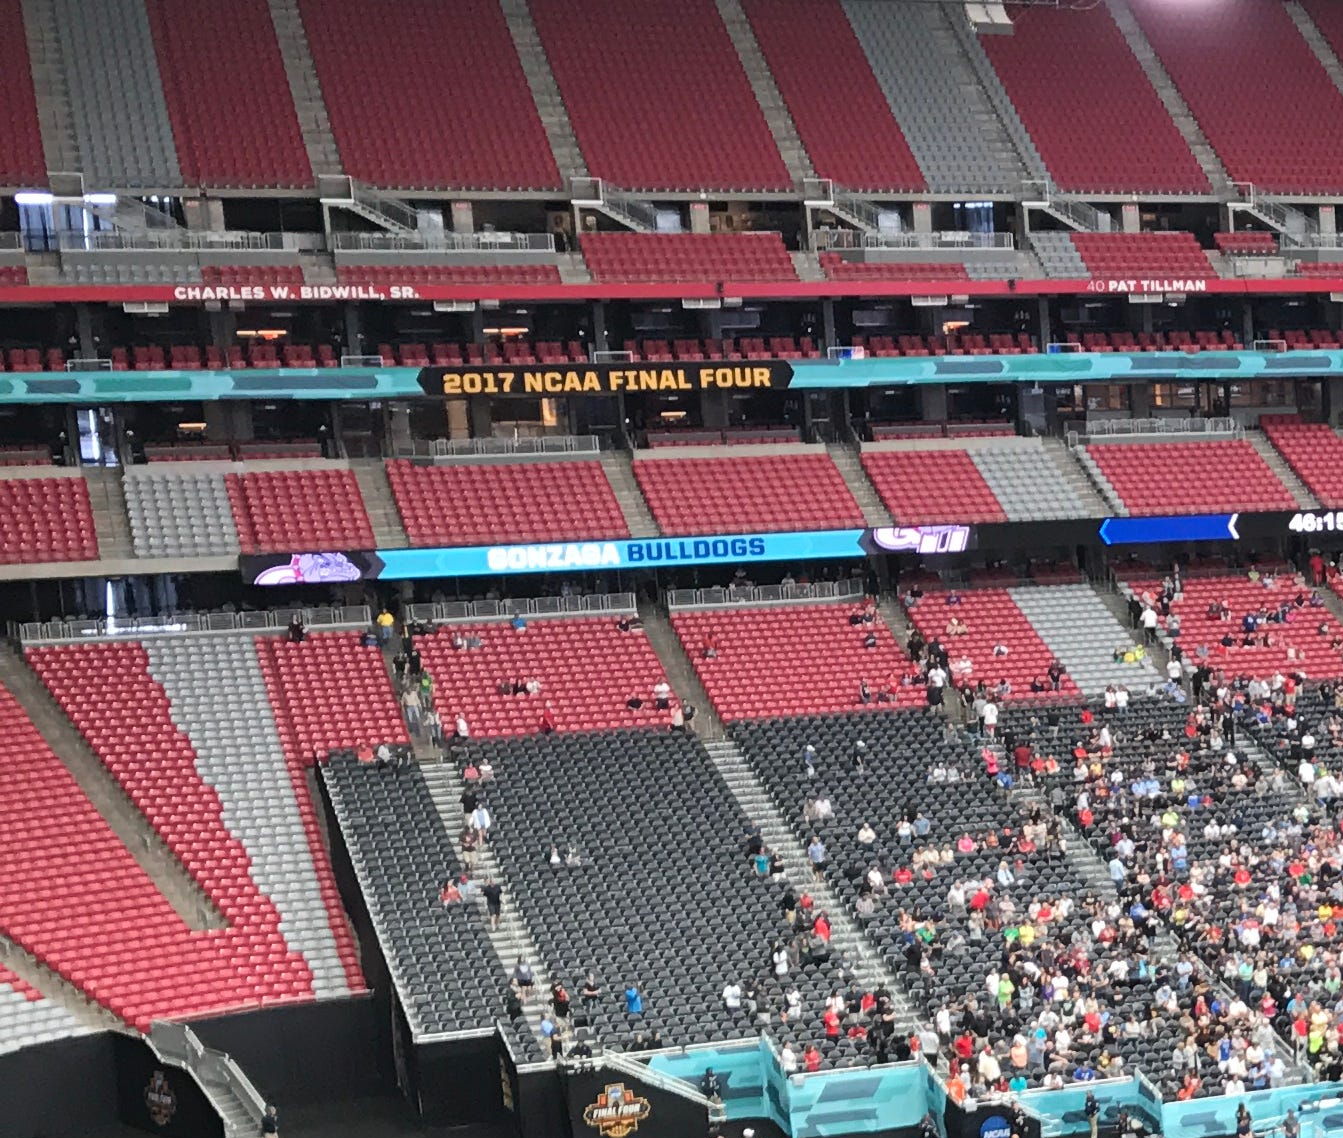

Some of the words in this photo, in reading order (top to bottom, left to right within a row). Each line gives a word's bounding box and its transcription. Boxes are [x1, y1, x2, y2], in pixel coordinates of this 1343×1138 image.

[174, 286, 264, 299] CHARLES
[270, 286, 295, 299] W.
[301, 286, 385, 301] BIDWILL,
[390, 286, 419, 299] SR.
[1087, 280, 1105, 292] 40
[1108, 280, 1137, 291] PAT
[1141, 279, 1206, 291] TILLMAN
[443, 372, 516, 394] 2017
[524, 371, 601, 393] NCAA
[609, 369, 692, 391] FINAL
[700, 367, 772, 388] FOUR
[627, 537, 765, 562] BULLDOGS
[593, 1106, 617, 1119] FINAL
[617, 1103, 641, 1116] FOUR
